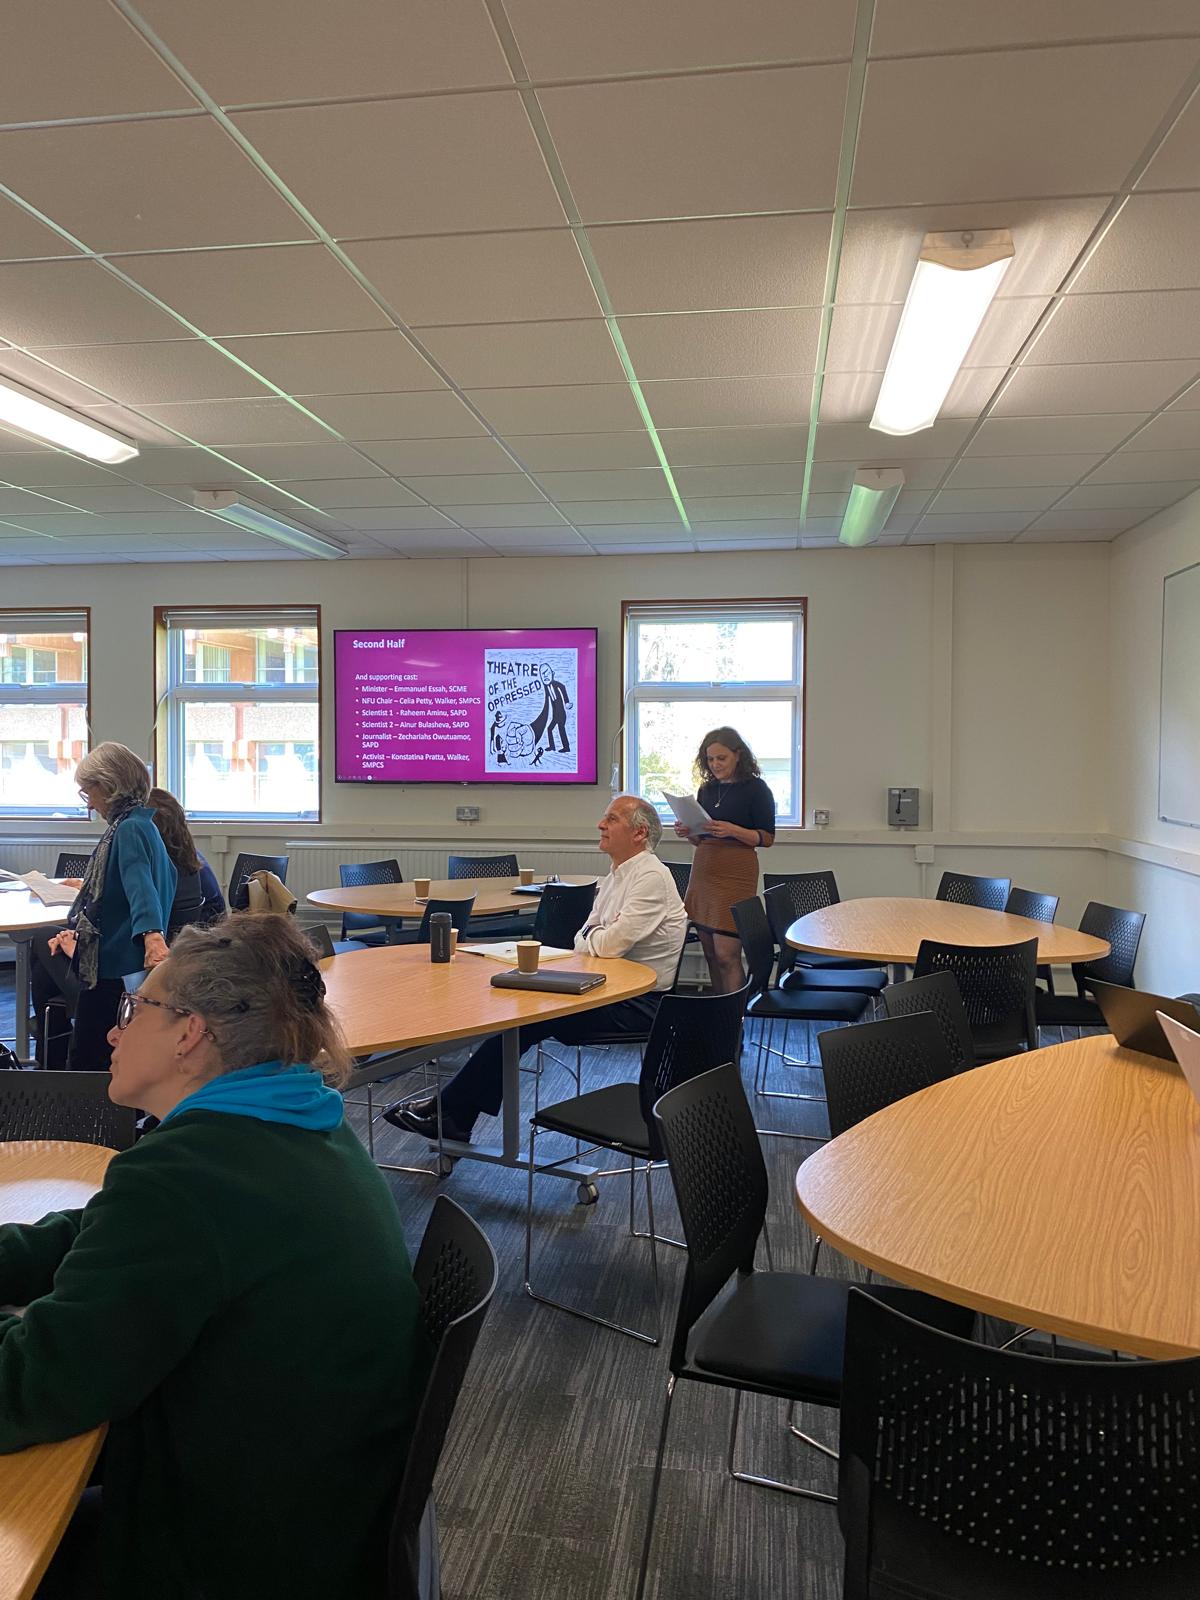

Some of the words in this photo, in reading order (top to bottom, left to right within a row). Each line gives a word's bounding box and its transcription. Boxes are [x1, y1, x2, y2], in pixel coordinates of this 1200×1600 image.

[353, 640, 384, 648] Second
[387, 639, 405, 648] Half
[487, 661, 538, 677] THEATRE
[488, 682, 499, 696] OF
[501, 677, 517, 690] THE
[488, 680, 542, 712] OPPRESSED
